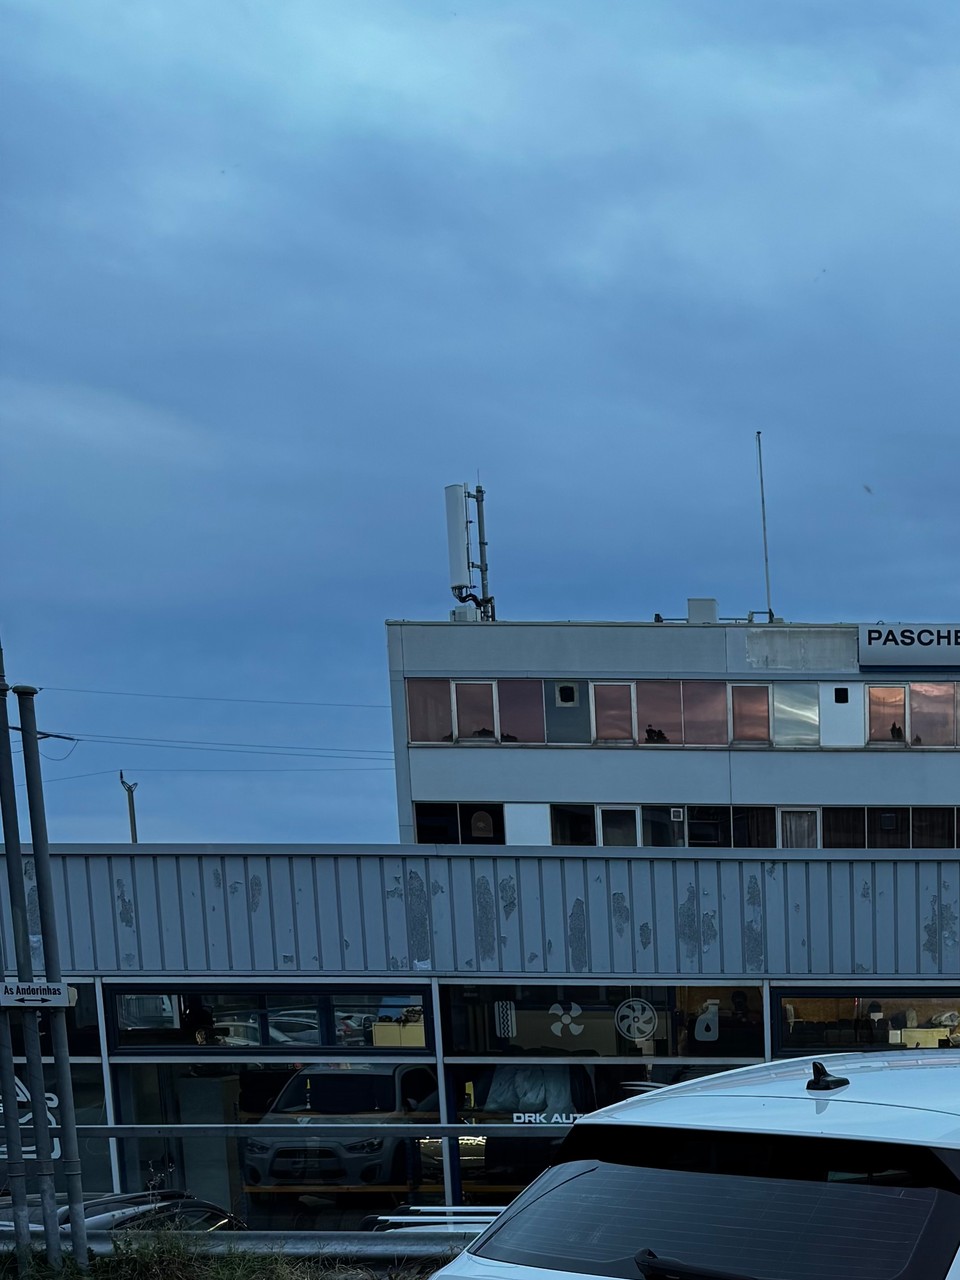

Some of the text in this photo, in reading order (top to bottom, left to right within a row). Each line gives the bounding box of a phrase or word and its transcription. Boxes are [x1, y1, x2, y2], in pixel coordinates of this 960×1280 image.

[4, 985, 62, 995] As Andorinhas
[512, 1113, 589, 1123] DRK AUT
